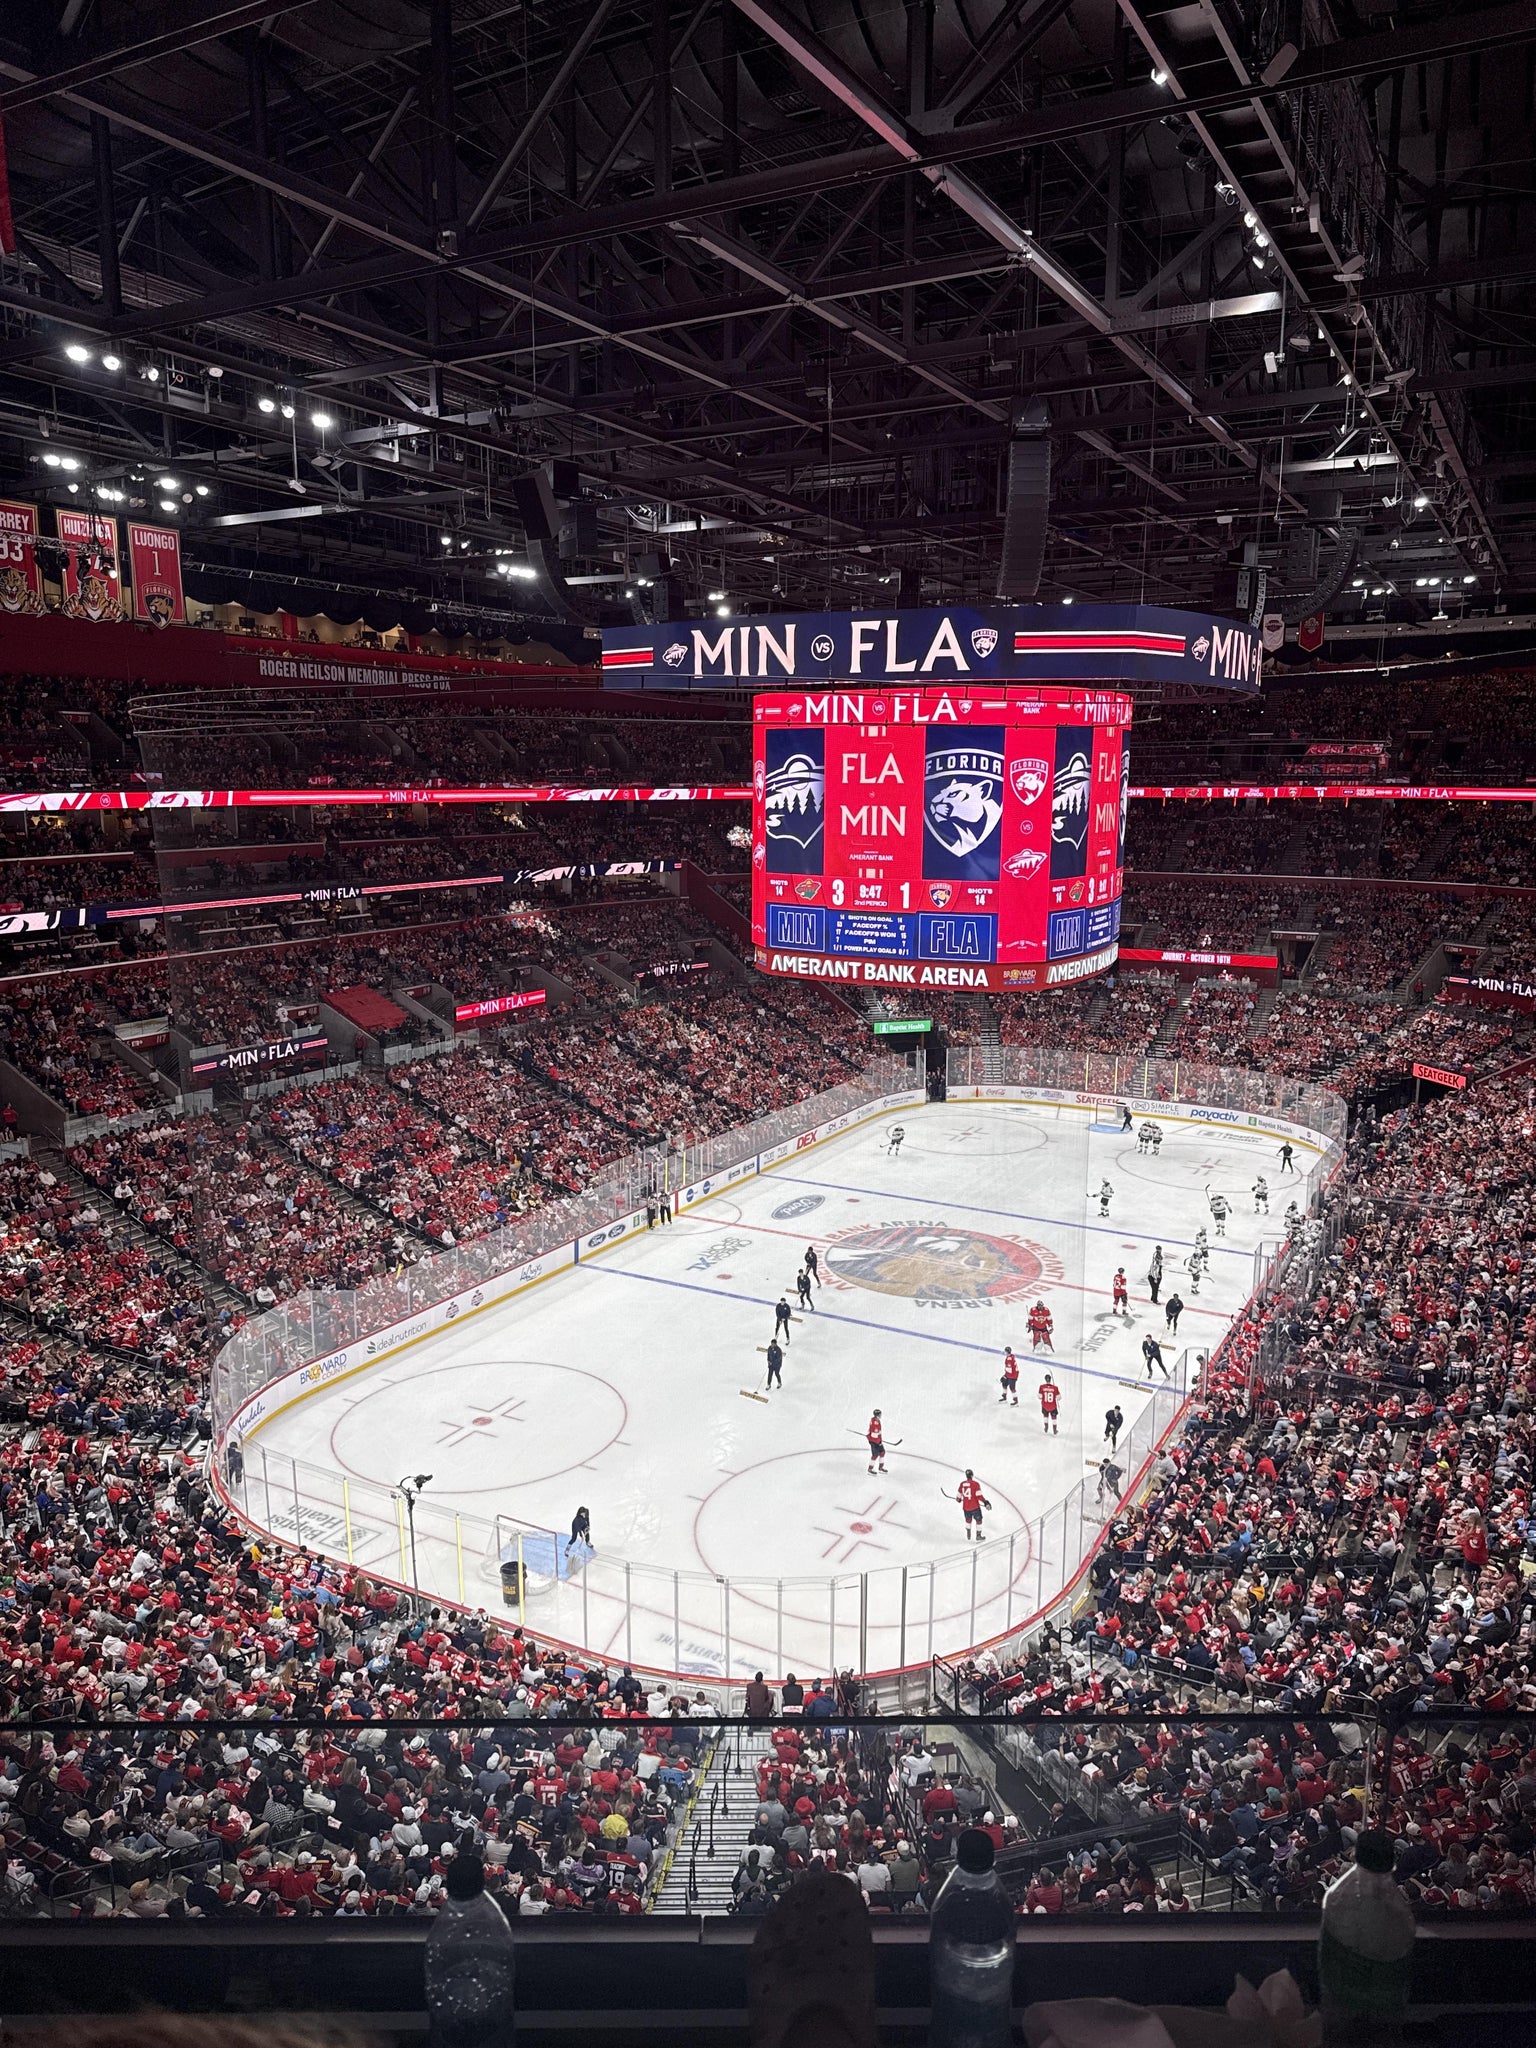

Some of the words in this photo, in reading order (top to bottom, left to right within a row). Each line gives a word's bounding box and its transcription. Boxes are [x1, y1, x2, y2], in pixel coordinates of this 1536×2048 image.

[134, 530, 175, 550] LUONGO
[152, 551, 162, 576] 1
[691, 624, 796, 678] MIN
[814, 642, 831, 654] VS
[850, 617, 970, 673] FLA
[1210, 625, 1251, 681] MIN
[259, 659, 298, 678] ROGER
[300, 663, 345, 682] NEILSON
[347, 667, 399, 685] MEMORIAL
[402, 672, 431, 688] PRESS
[805, 695, 864, 723] MIN
[893, 691, 957, 722] FLA
[1084, 693, 1110, 722] MIN
[842, 753, 904, 784] FLA
[925, 755, 1002, 774] FLORIDA
[1098, 752, 1117, 783] FLA
[389, 792, 407, 802] MIN
[412, 791, 428, 801] FLA
[1207, 788, 1212, 797] 3
[1273, 788, 1278, 797] 1
[1400, 788, 1421, 798] MIN
[1429, 788, 1449, 798] FLA
[840, 805, 907, 836] MIN
[1095, 803, 1116, 833] MIN
[310, 889, 331, 901] MIN
[337, 886, 356, 899] FLA
[775, 886, 783, 896] 14
[832, 879, 845, 906] 3
[900, 882, 910, 909] 1
[968, 887, 993, 895] SHOTS
[975, 894, 986, 906] 14
[1088, 877, 1095, 904] 3
[778, 911, 817, 945] MIN
[930, 920, 979, 955] FLA
[1161, 952, 1186, 961] JOURNEY
[1190, 953, 1215, 963] OCTOBER
[771, 955, 862, 979] AMERANT
[864, 961, 916, 983] BANK
[919, 966, 989, 987] ARENA
[1046, 956, 1097, 985] AMERANT
[1478, 977, 1504, 992] MIN
[1512, 980, 1533, 998] FLA
[480, 1001, 500, 1016] MIN
[506, 996, 523, 1009] FLA
[229, 1049, 258, 1069] MIN
[269, 1044, 294, 1060] FLA
[1418, 1066, 1460, 1087] SEATGEEK
[1151, 1102, 1179, 1111] SIMPLE
[1190, 1109, 1239, 1122] payactiv
[1258, 1120, 1276, 1129] Baptist
[1277, 1124, 1292, 1133] Health
[796, 1130, 818, 1150] DEX
[826, 1223, 873, 1240] BANK
[880, 1220, 949, 1228] ARENA
[1003, 1234, 1065, 1280] AMERANT
[999, 1281, 1053, 1304] BANK
[915, 1299, 994, 1309] ARENA
[1395, 1322, 1405, 1332] 55
[1081, 1324, 1118, 1353] CELSIUS
[300, 1353, 347, 1385] BROWARD
[322, 1365, 347, 1381] COUNTY
[1044, 1392, 1053, 1403] 18
[74, 1483, 83, 1495] 9
[962, 1487, 971, 1500] 14
[288, 1504, 344, 1529] Health
[264, 1514, 327, 1541] Baptist
[609, 1870, 625, 1889] 19
